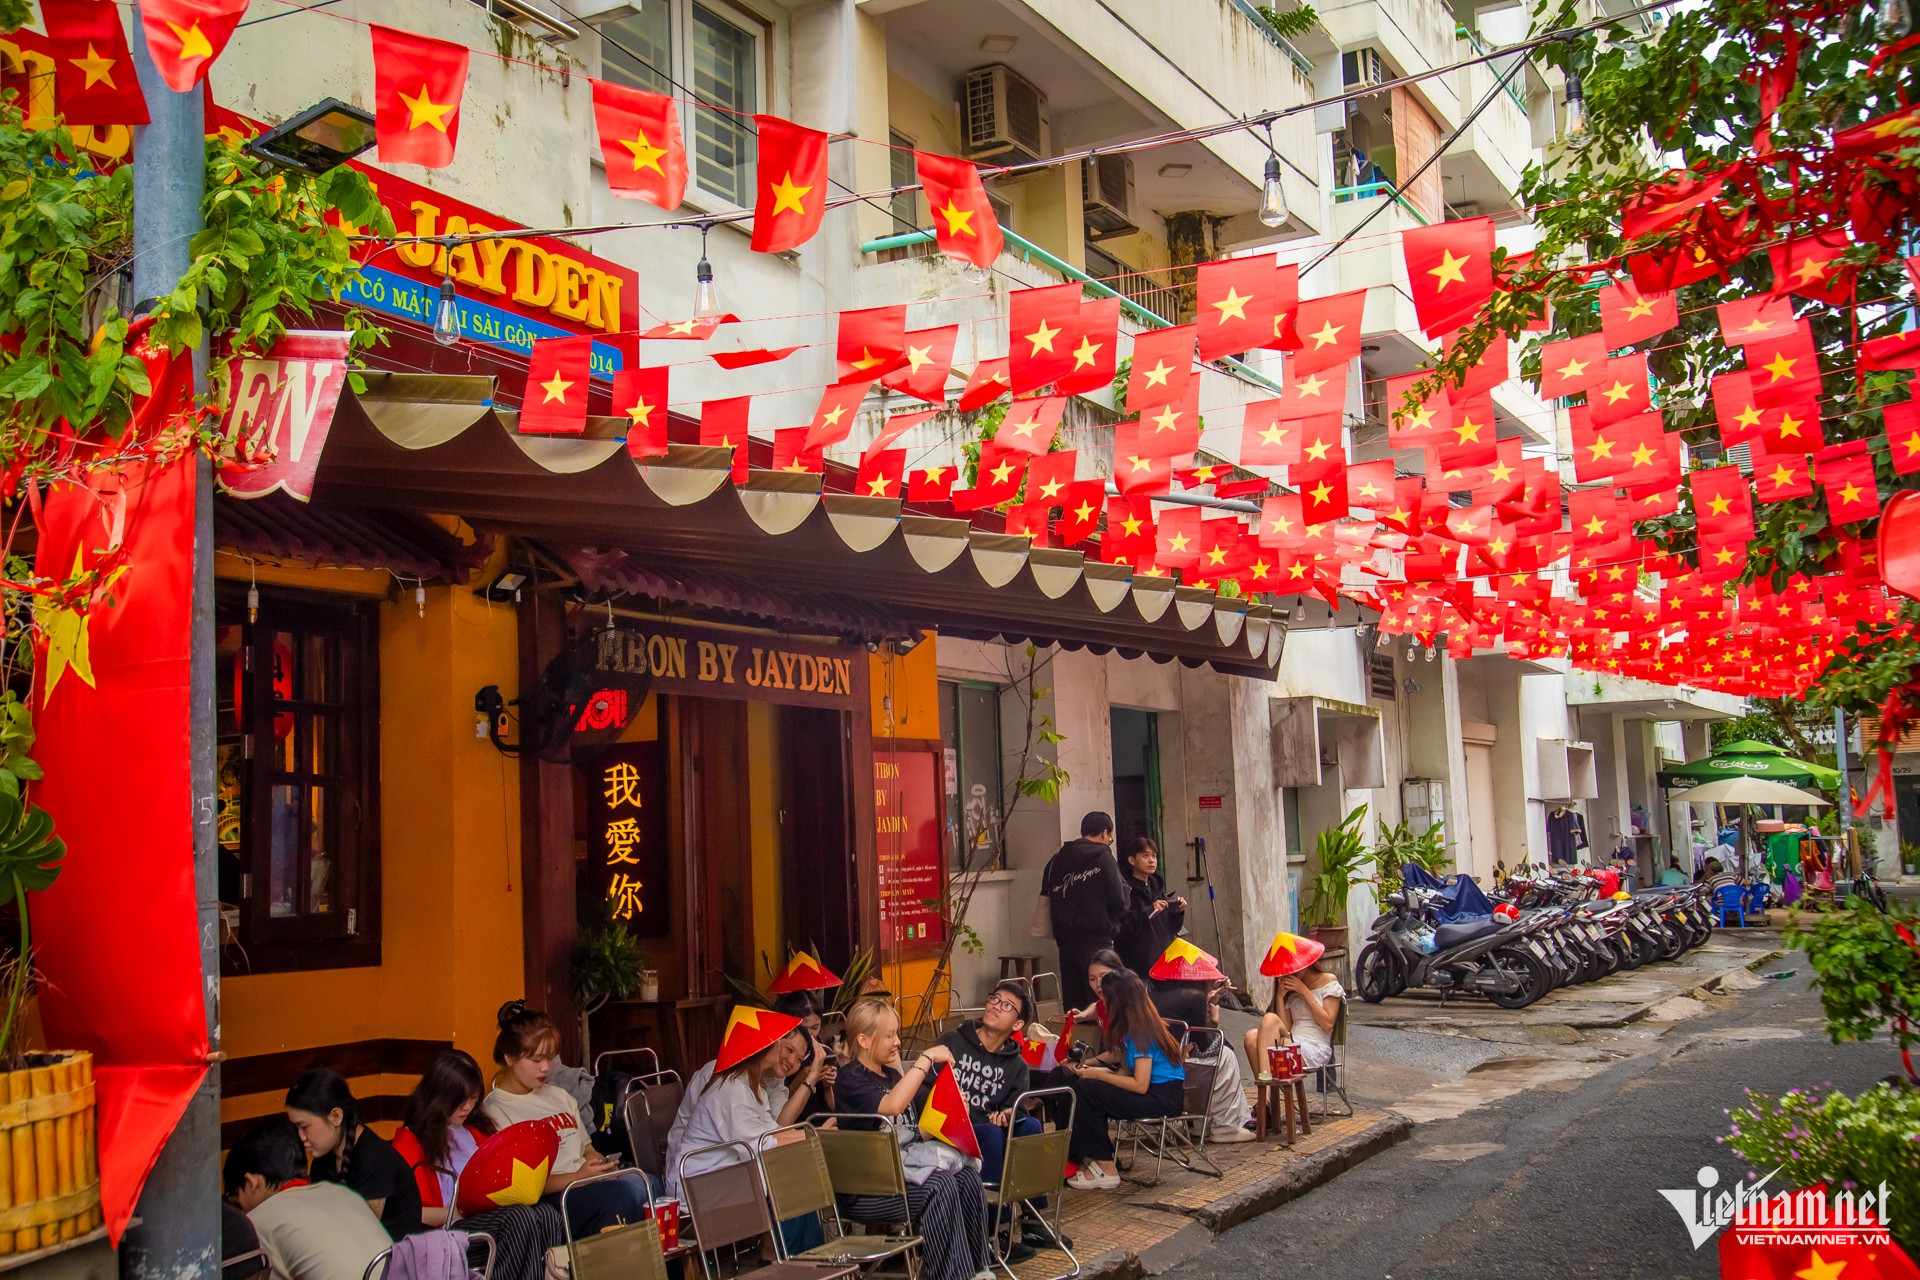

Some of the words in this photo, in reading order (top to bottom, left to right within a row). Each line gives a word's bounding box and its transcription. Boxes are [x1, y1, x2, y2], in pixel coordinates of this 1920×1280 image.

[395, 200, 624, 333] JAYDEN
[359, 277, 385, 303] CÓ
[392, 287, 433, 318] MẶT
[473, 312, 501, 339] SÀI
[505, 323, 537, 349] GÒN
[589, 351, 614, 374] 014
[697, 640, 739, 684] BY
[745, 647, 851, 696] JAYDEN
[874, 762, 900, 780] TIBON
[1671, 776, 1699, 788] Carlsberg
[1709, 758, 1771, 771] Carlsberg
[875, 789, 888, 806] BY
[603, 761, 643, 920] 我愛你
